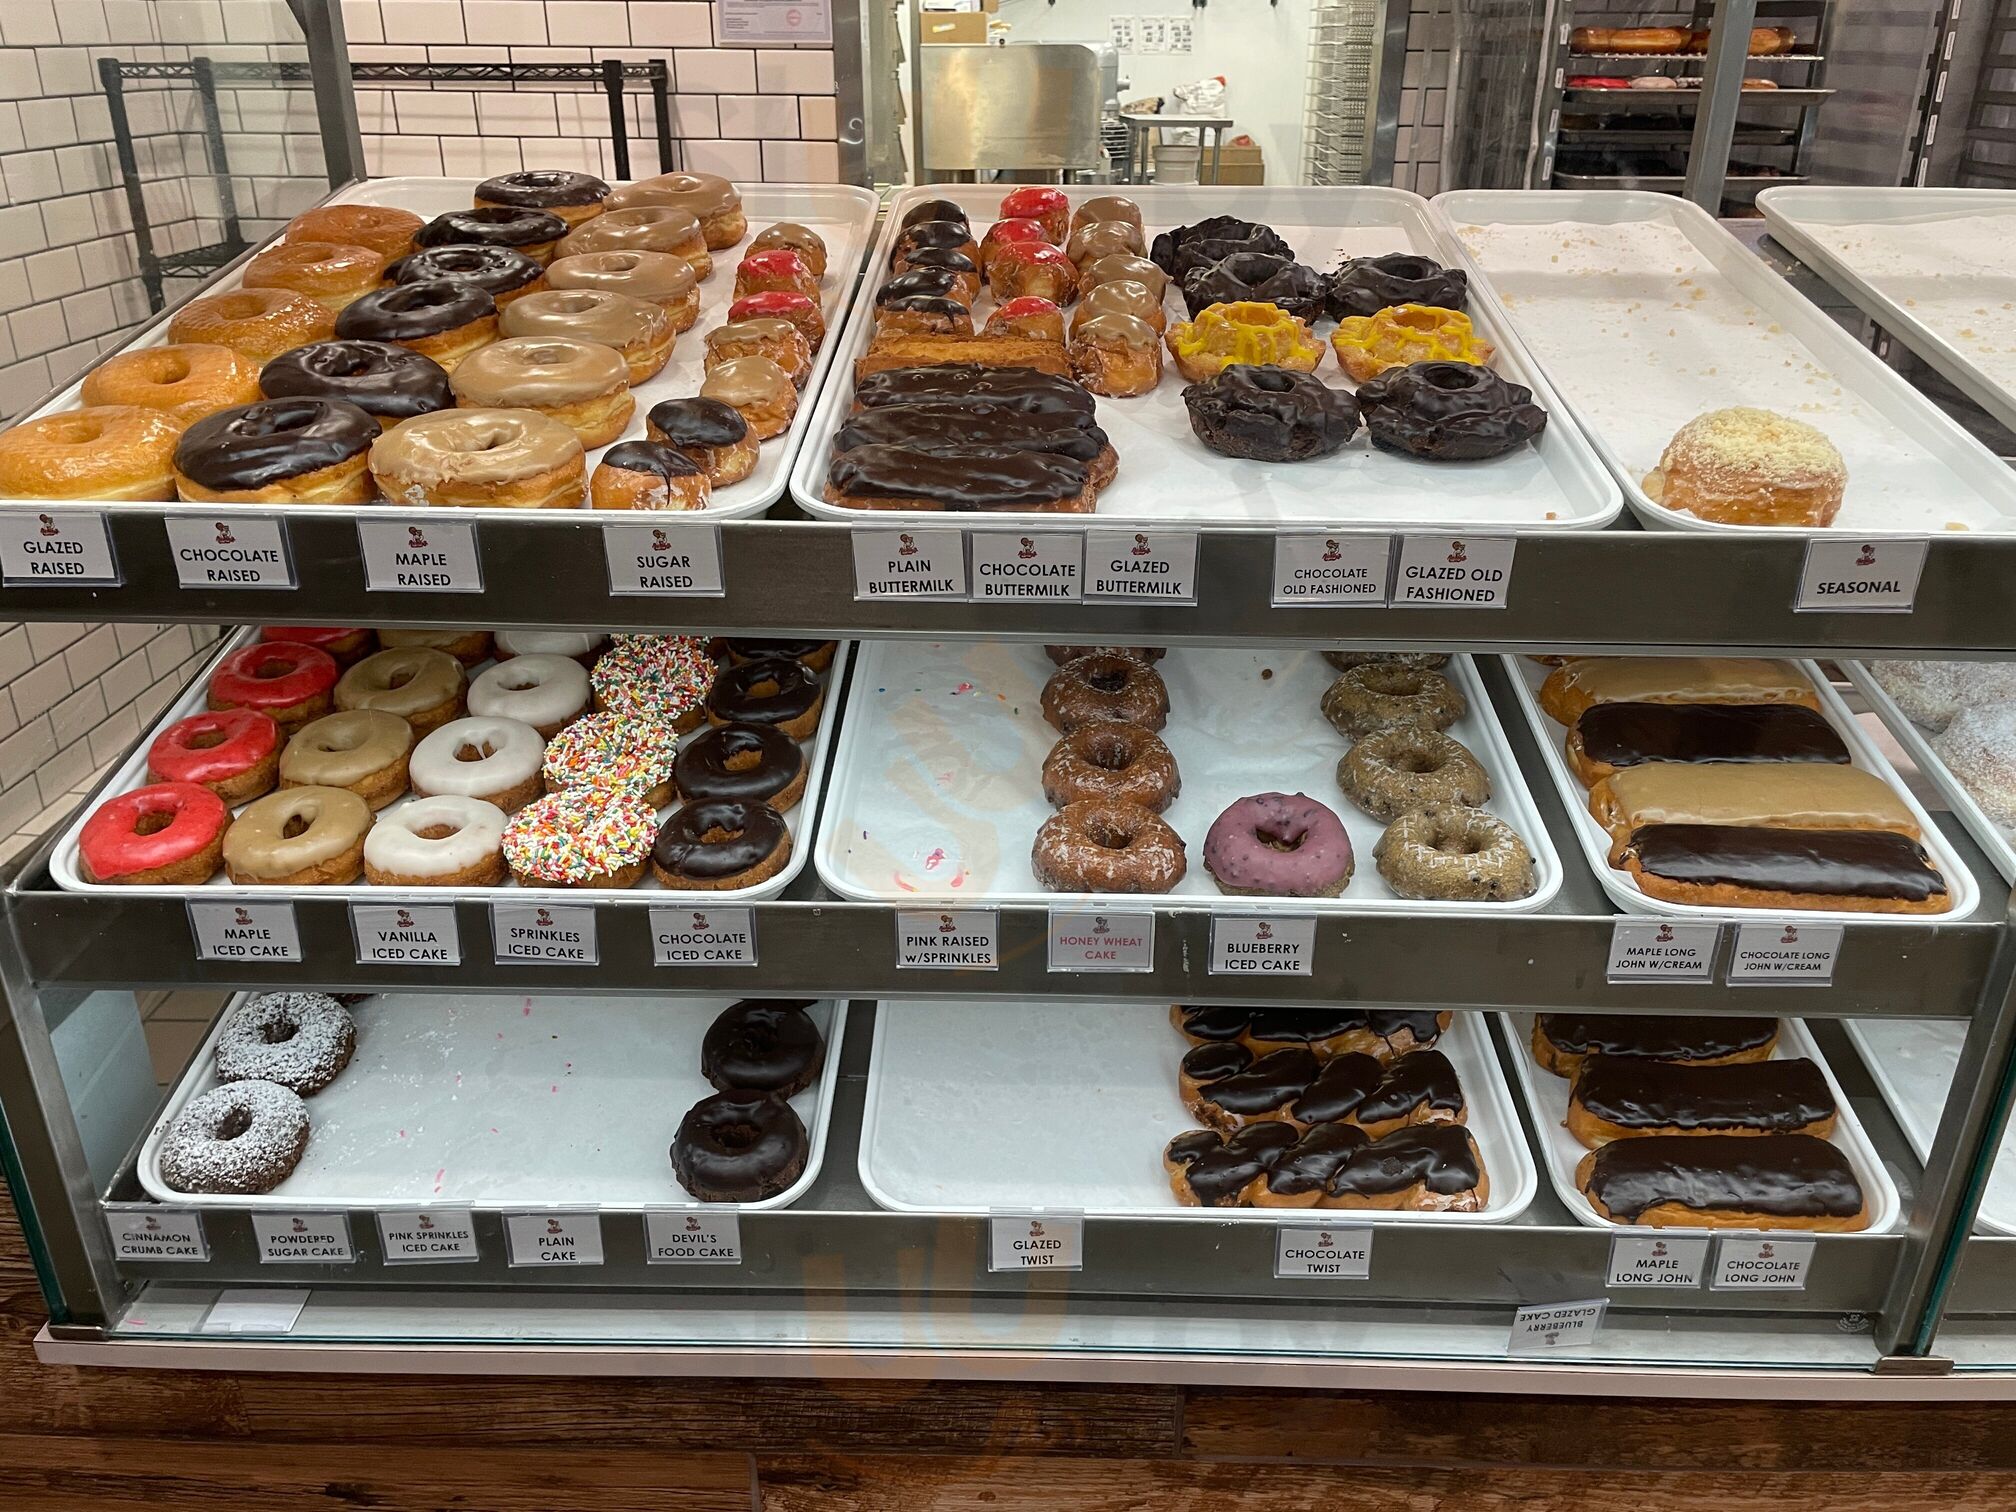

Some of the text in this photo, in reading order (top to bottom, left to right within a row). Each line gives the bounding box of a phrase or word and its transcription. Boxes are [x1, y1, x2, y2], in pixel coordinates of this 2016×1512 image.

[23, 541, 84, 554] GLAZED
[180, 549, 279, 562] CHOCOLATE
[396, 553, 447, 566] MAPLE
[637, 556, 691, 568] SUGAR
[888, 559, 931, 573] PLAIN
[1110, 560, 1170, 574] GLAZED
[31, 562, 84, 575] RAISED
[979, 563, 1076, 577] CHOCOLATE
[1294, 568, 1368, 579] CHOCOLATE
[1405, 566, 1503, 582] GLAZED OLD
[207, 569, 261, 582] RAISED
[398, 573, 451, 586] RAISED
[640, 576, 693, 588] RAISED
[869, 579, 954, 594] BUTTERMILK
[1096, 580, 1182, 595] BUTTERMILK
[1817, 581, 1901, 594] SEASONAL
[985, 584, 1069, 596] BUTTERMILK
[1283, 584, 1377, 595] OLD FASHIONED
[1406, 587, 1495, 602] FASHIONED
[224, 929, 271, 940] MAPLE
[378, 931, 437, 943] VANILLA
[510, 927, 580, 943] SPRINKLES
[659, 933, 746, 944] CHOCOLATE
[906, 937, 989, 947] PINK RAISED
[1060, 936, 1143, 947] HONEY WHEAT
[213, 945, 289, 957] ICED CAKE
[372, 948, 448, 960] ICED CAKE
[508, 943, 584, 959] ICED CAKE
[1227, 943, 1300, 954] BLUEBERRY
[1626, 948, 1697, 957] MAPLE LONG
[667, 949, 742, 961] ICED CAKE
[905, 953, 991, 964] w/SPRINKLES
[1085, 951, 1117, 960] CAKE
[1740, 951, 1830, 960] CHOCOLATE LONG
[1225, 960, 1300, 970] ICED CAKE
[1616, 960, 1702, 969] JOHN W/CREAM
[1744, 963, 1821, 971] JOHN W/CREAM
[122, 1233, 191, 1242] CINNAMON
[271, 1235, 335, 1244] POWDERED
[389, 1230, 469, 1241] PINK SPRINKLES
[672, 1234, 717, 1243] DEVIL'S
[538, 1237, 574, 1246] PLAIN
[1013, 1240, 1061, 1250] GLAZED
[121, 1245, 199, 1255] CRUMB CAKE
[268, 1247, 344, 1257] SUGAR CAKE
[402, 1243, 460, 1253] ICED CAKE
[658, 1248, 734, 1257] FOOD CAKE
[541, 1252, 576, 1261] CAKE
[1285, 1249, 1365, 1259] CHOCOLATE
[1021, 1255, 1054, 1265] TWIST
[1635, 1259, 1679, 1269] MAPLE
[1727, 1260, 1800, 1270] CHOCOLATE
[1307, 1264, 1341, 1273] TWIST
[1616, 1273, 1693, 1283] LONG JOHN
[1725, 1274, 1795, 1283] LONG JOHN
[1520, 1308, 1596, 1321] GLAZED CAKE
[1526, 1321, 1584, 1332] BLUEBERRY
